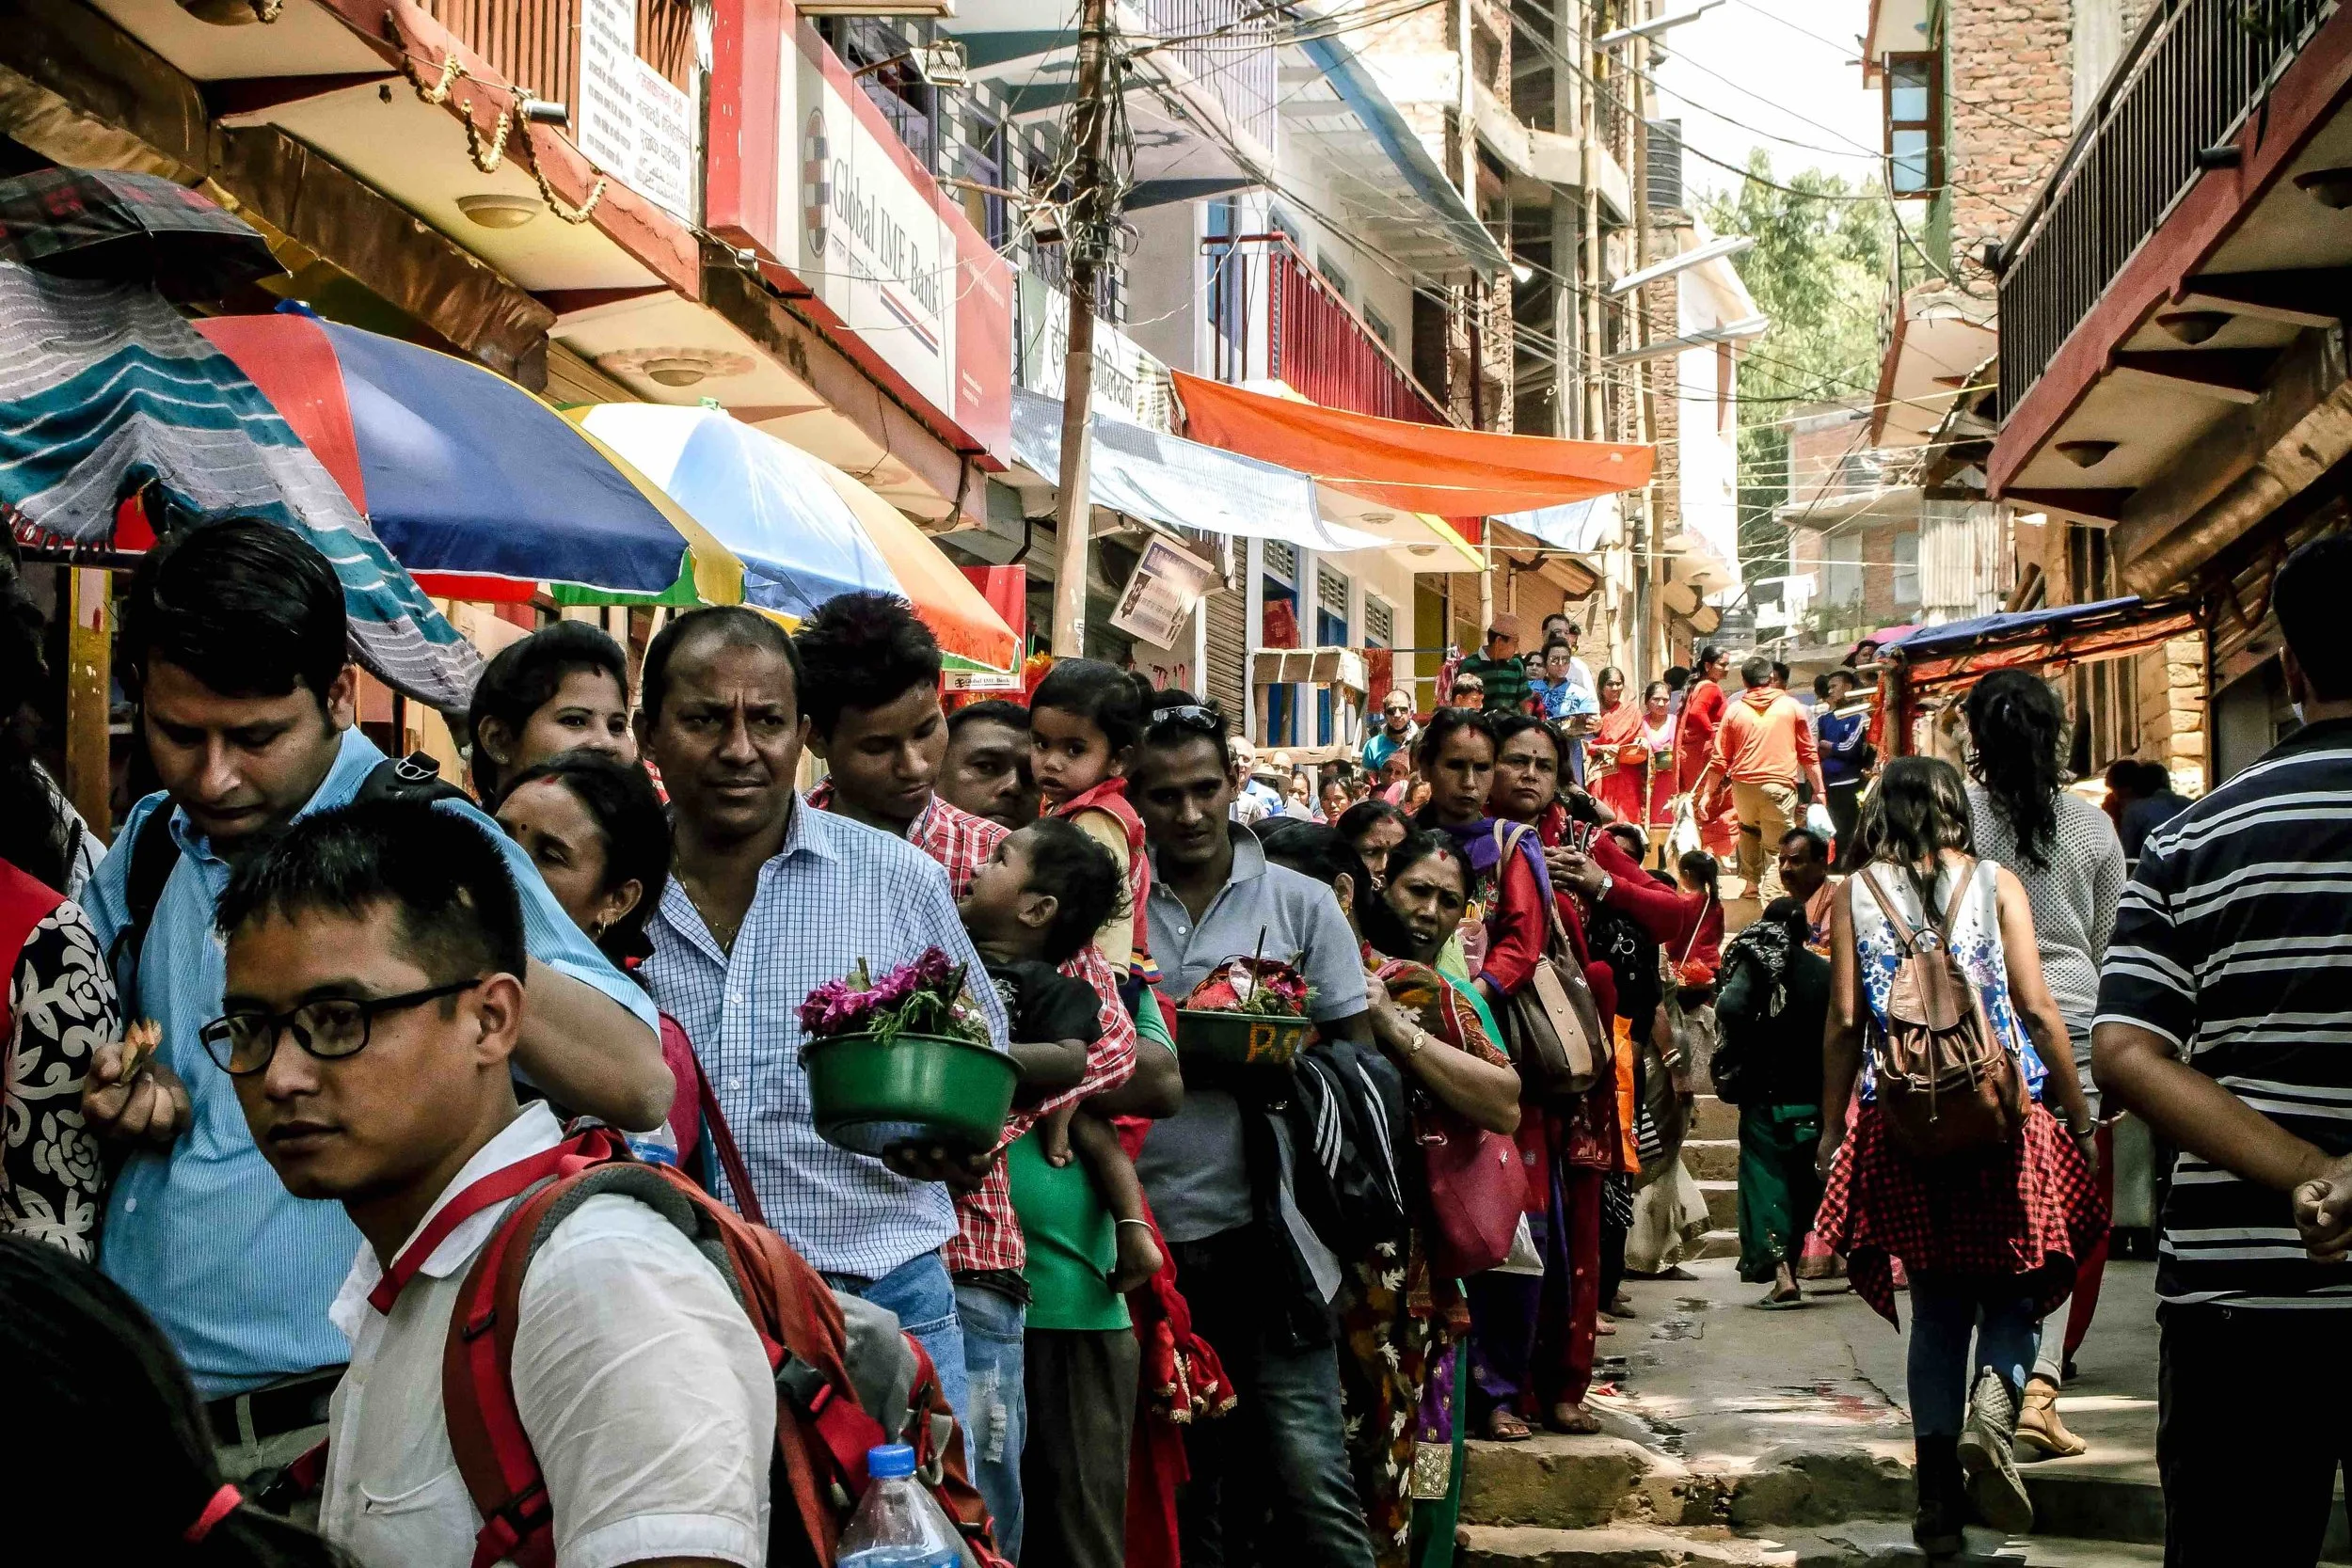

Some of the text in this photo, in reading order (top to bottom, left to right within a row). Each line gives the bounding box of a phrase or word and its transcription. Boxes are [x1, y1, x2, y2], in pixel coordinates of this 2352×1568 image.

[834, 158, 875, 254] Global
[881, 207, 906, 286] IME
[911, 241, 939, 321] Bank
